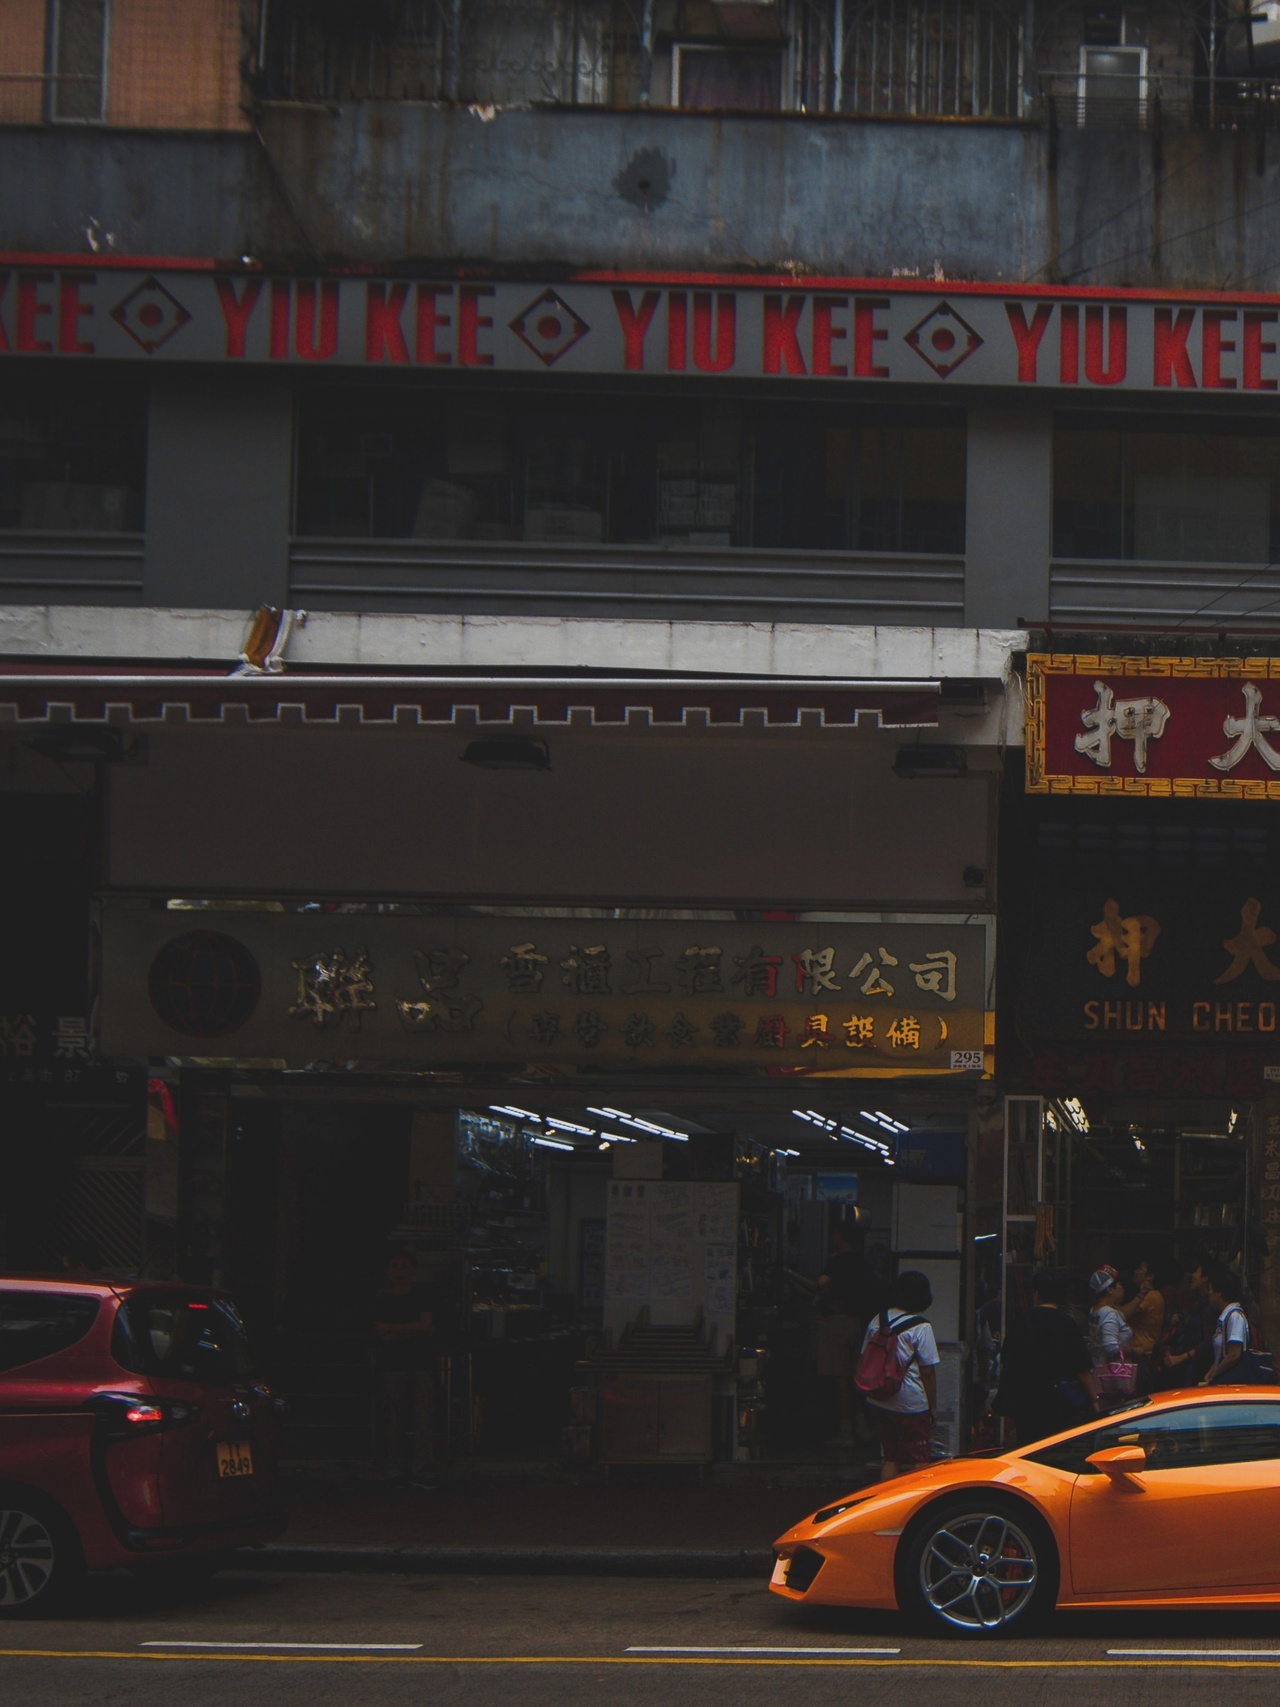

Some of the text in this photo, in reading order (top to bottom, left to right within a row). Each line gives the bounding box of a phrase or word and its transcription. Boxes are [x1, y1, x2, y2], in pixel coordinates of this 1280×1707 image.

[215, 277, 496, 366] YIU KEE
[613, 289, 890, 377] YIU KEE
[1004, 302, 1278, 390] YIU KEE
[1083, 1000, 1166, 1032] SHUN
[953, 1052, 981, 1064] 295
[221, 1457, 250, 1476] 2849
